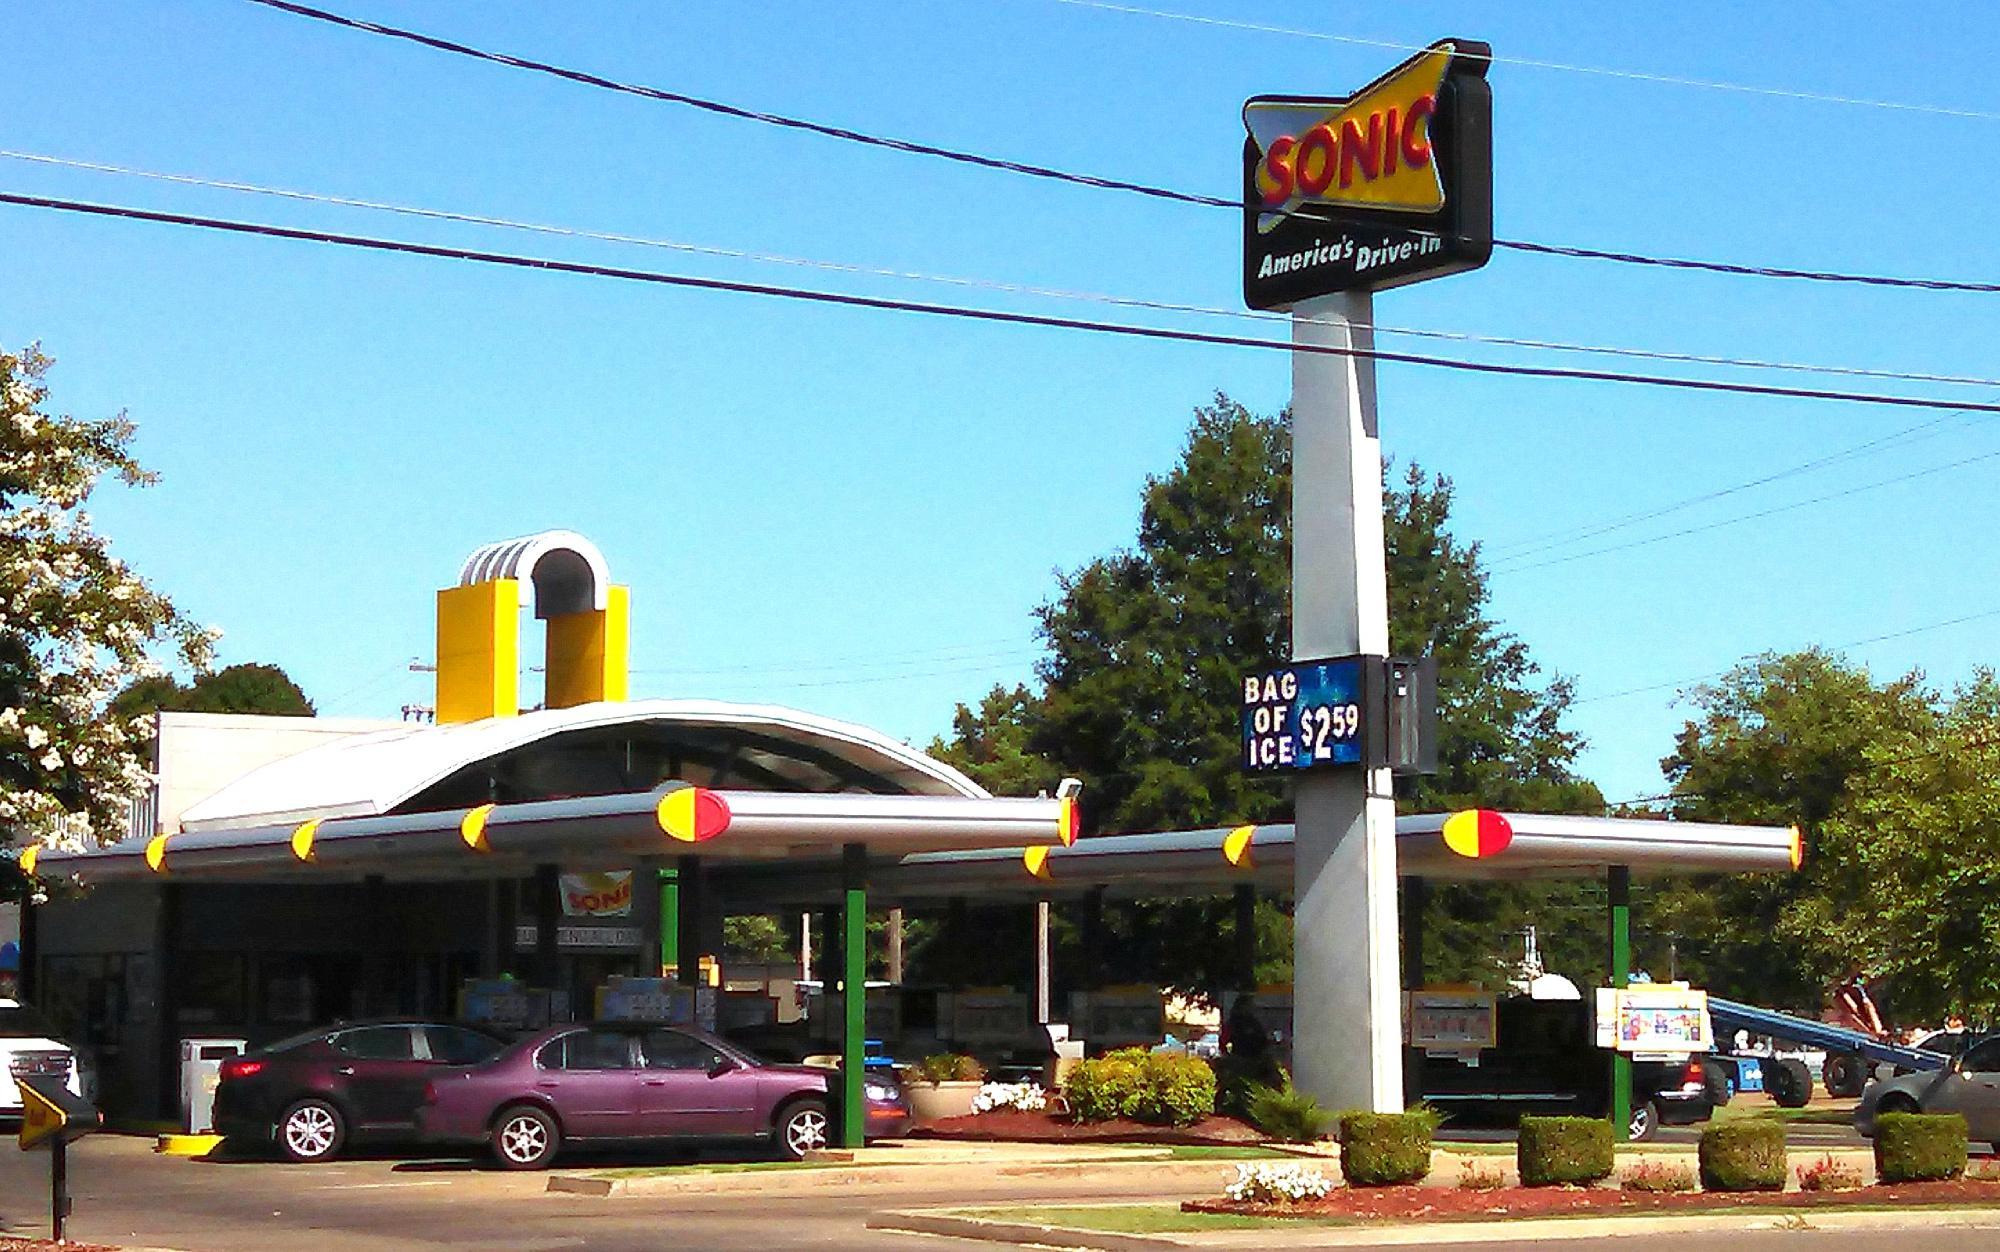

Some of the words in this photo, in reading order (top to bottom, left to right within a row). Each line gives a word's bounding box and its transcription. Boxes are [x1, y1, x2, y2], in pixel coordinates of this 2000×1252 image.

[1263, 94, 1436, 205] SONIC
[1257, 235, 1354, 279] America's
[1245, 672, 1297, 703] BAG
[1254, 706, 1288, 733] OF
[1250, 736, 1293, 766] ICE
